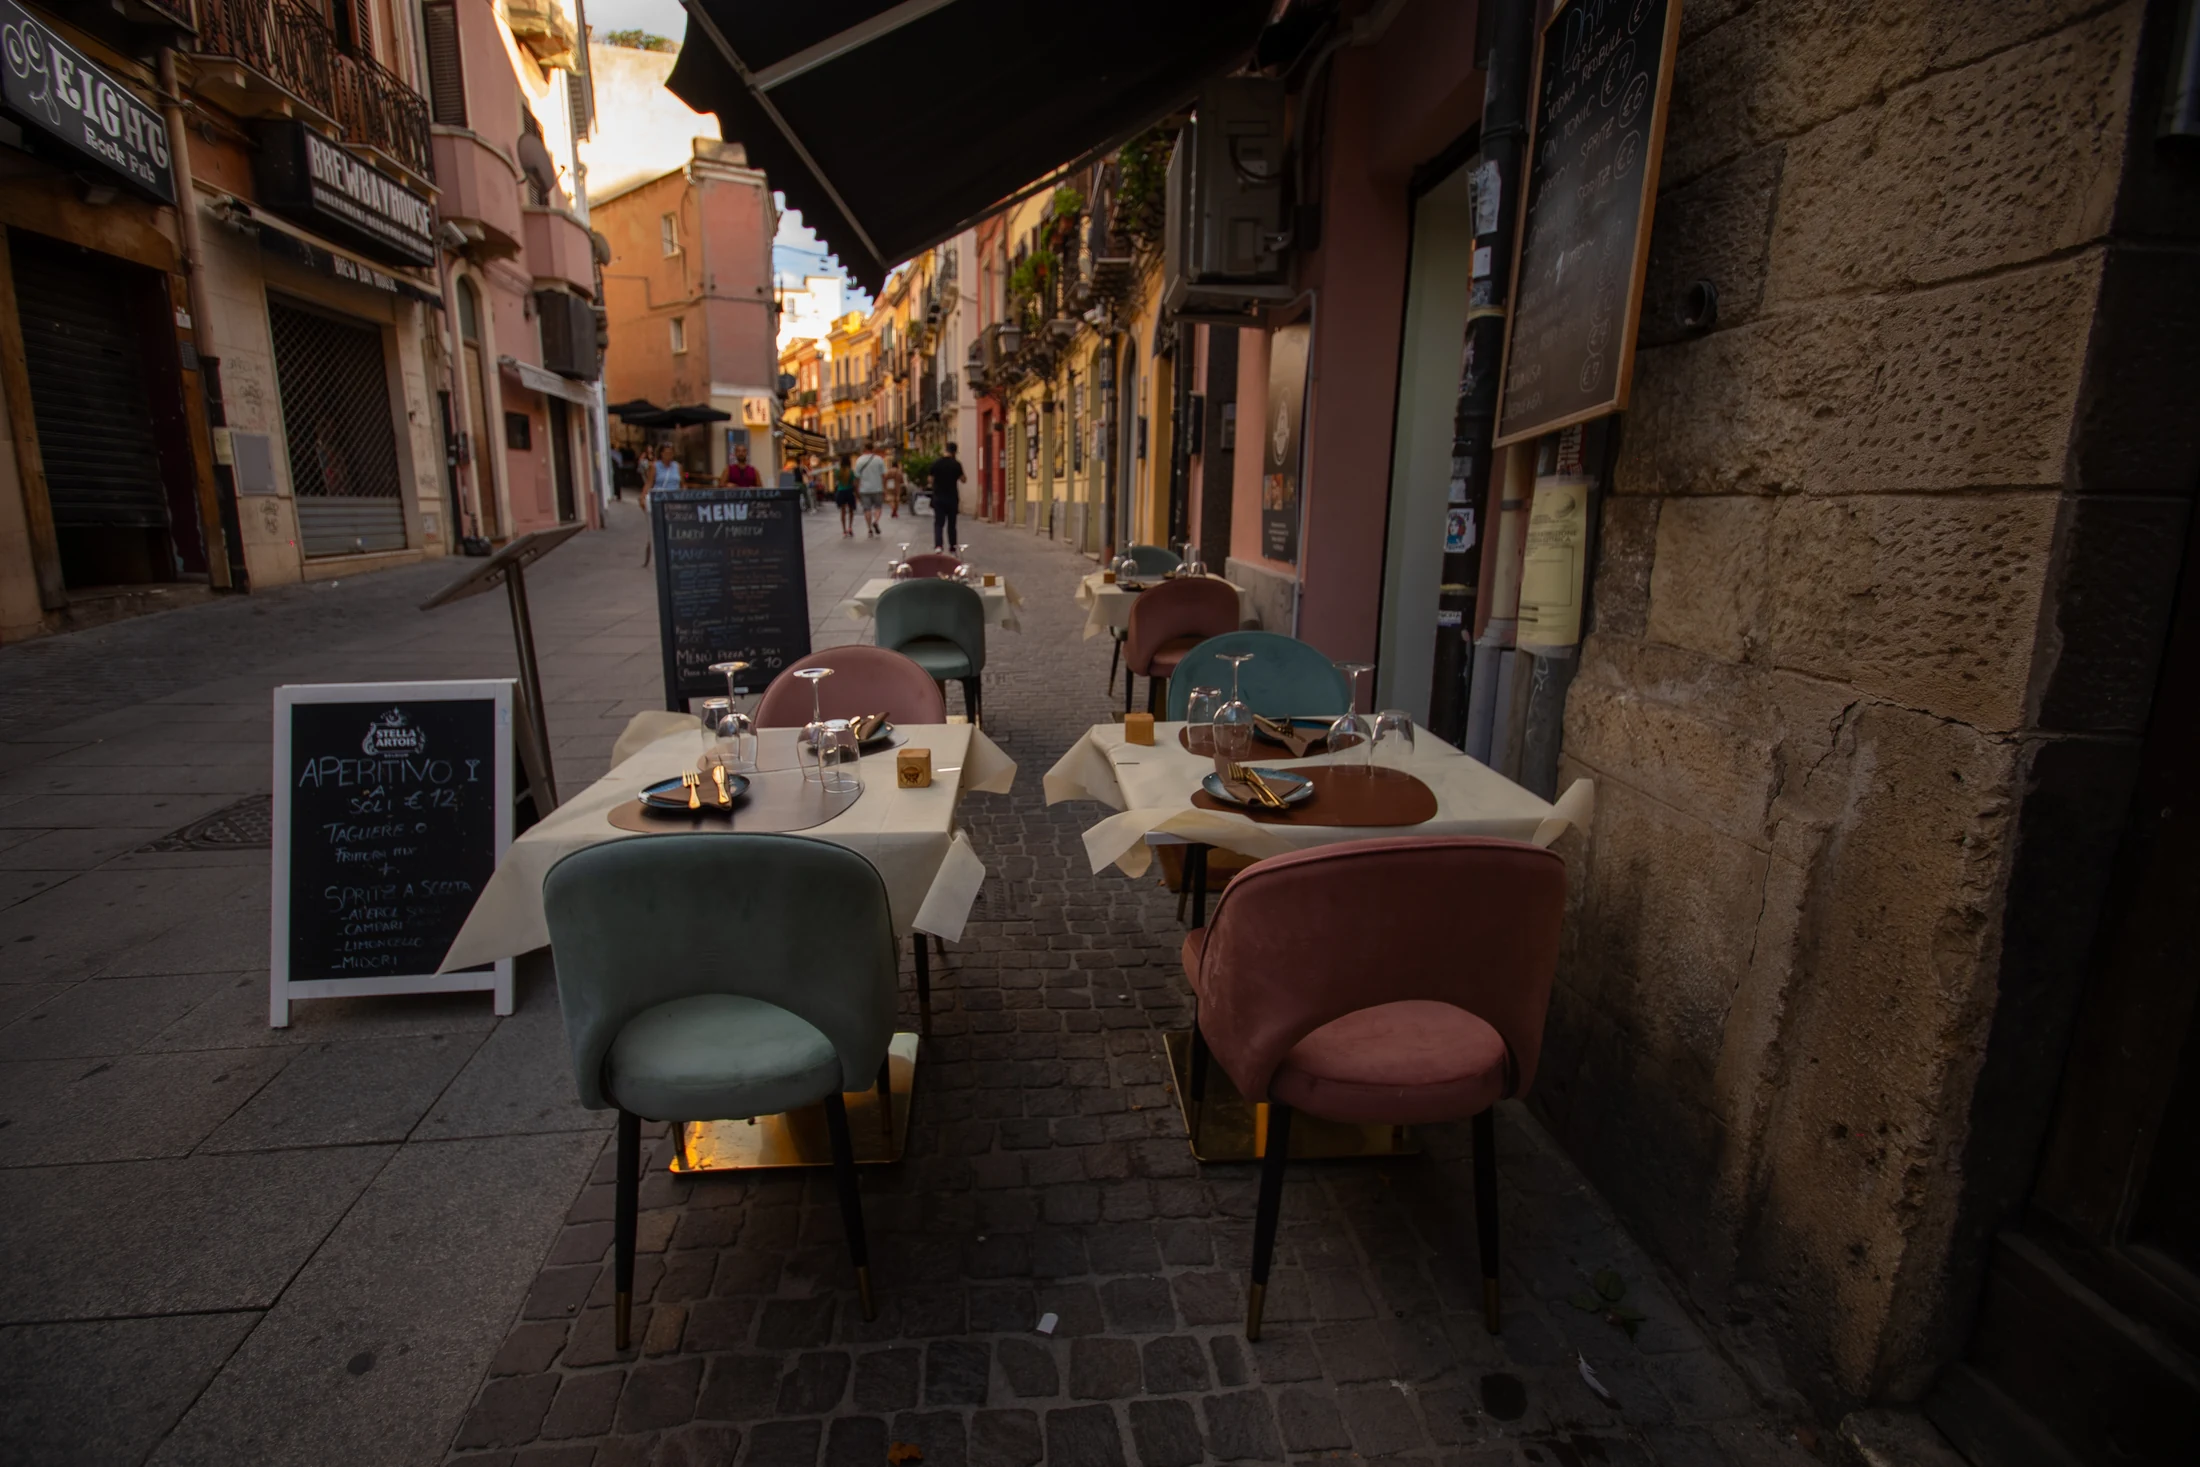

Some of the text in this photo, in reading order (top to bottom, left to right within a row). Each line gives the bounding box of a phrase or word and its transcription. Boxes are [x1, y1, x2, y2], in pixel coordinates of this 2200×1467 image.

[48, 42, 169, 169] EIGHT
[764, 656, 782, 669] 10
[376, 728, 417, 738] STELLA
[375, 738, 418, 748] ARTOIS
[298, 755, 453, 788] APERITIVO
[349, 798, 391, 815] SOLI
[430, 787, 457, 808] 12
[322, 822, 405, 844] TAGLIERE
[324, 884, 396, 914] SPRITZ
[403, 883, 414, 898] A
[421, 879, 473, 898] SCELTA
[344, 920, 403, 936] CAMPARI
[344, 937, 424, 952] LIMONCELLO
[341, 954, 398, 969] MIDORI
